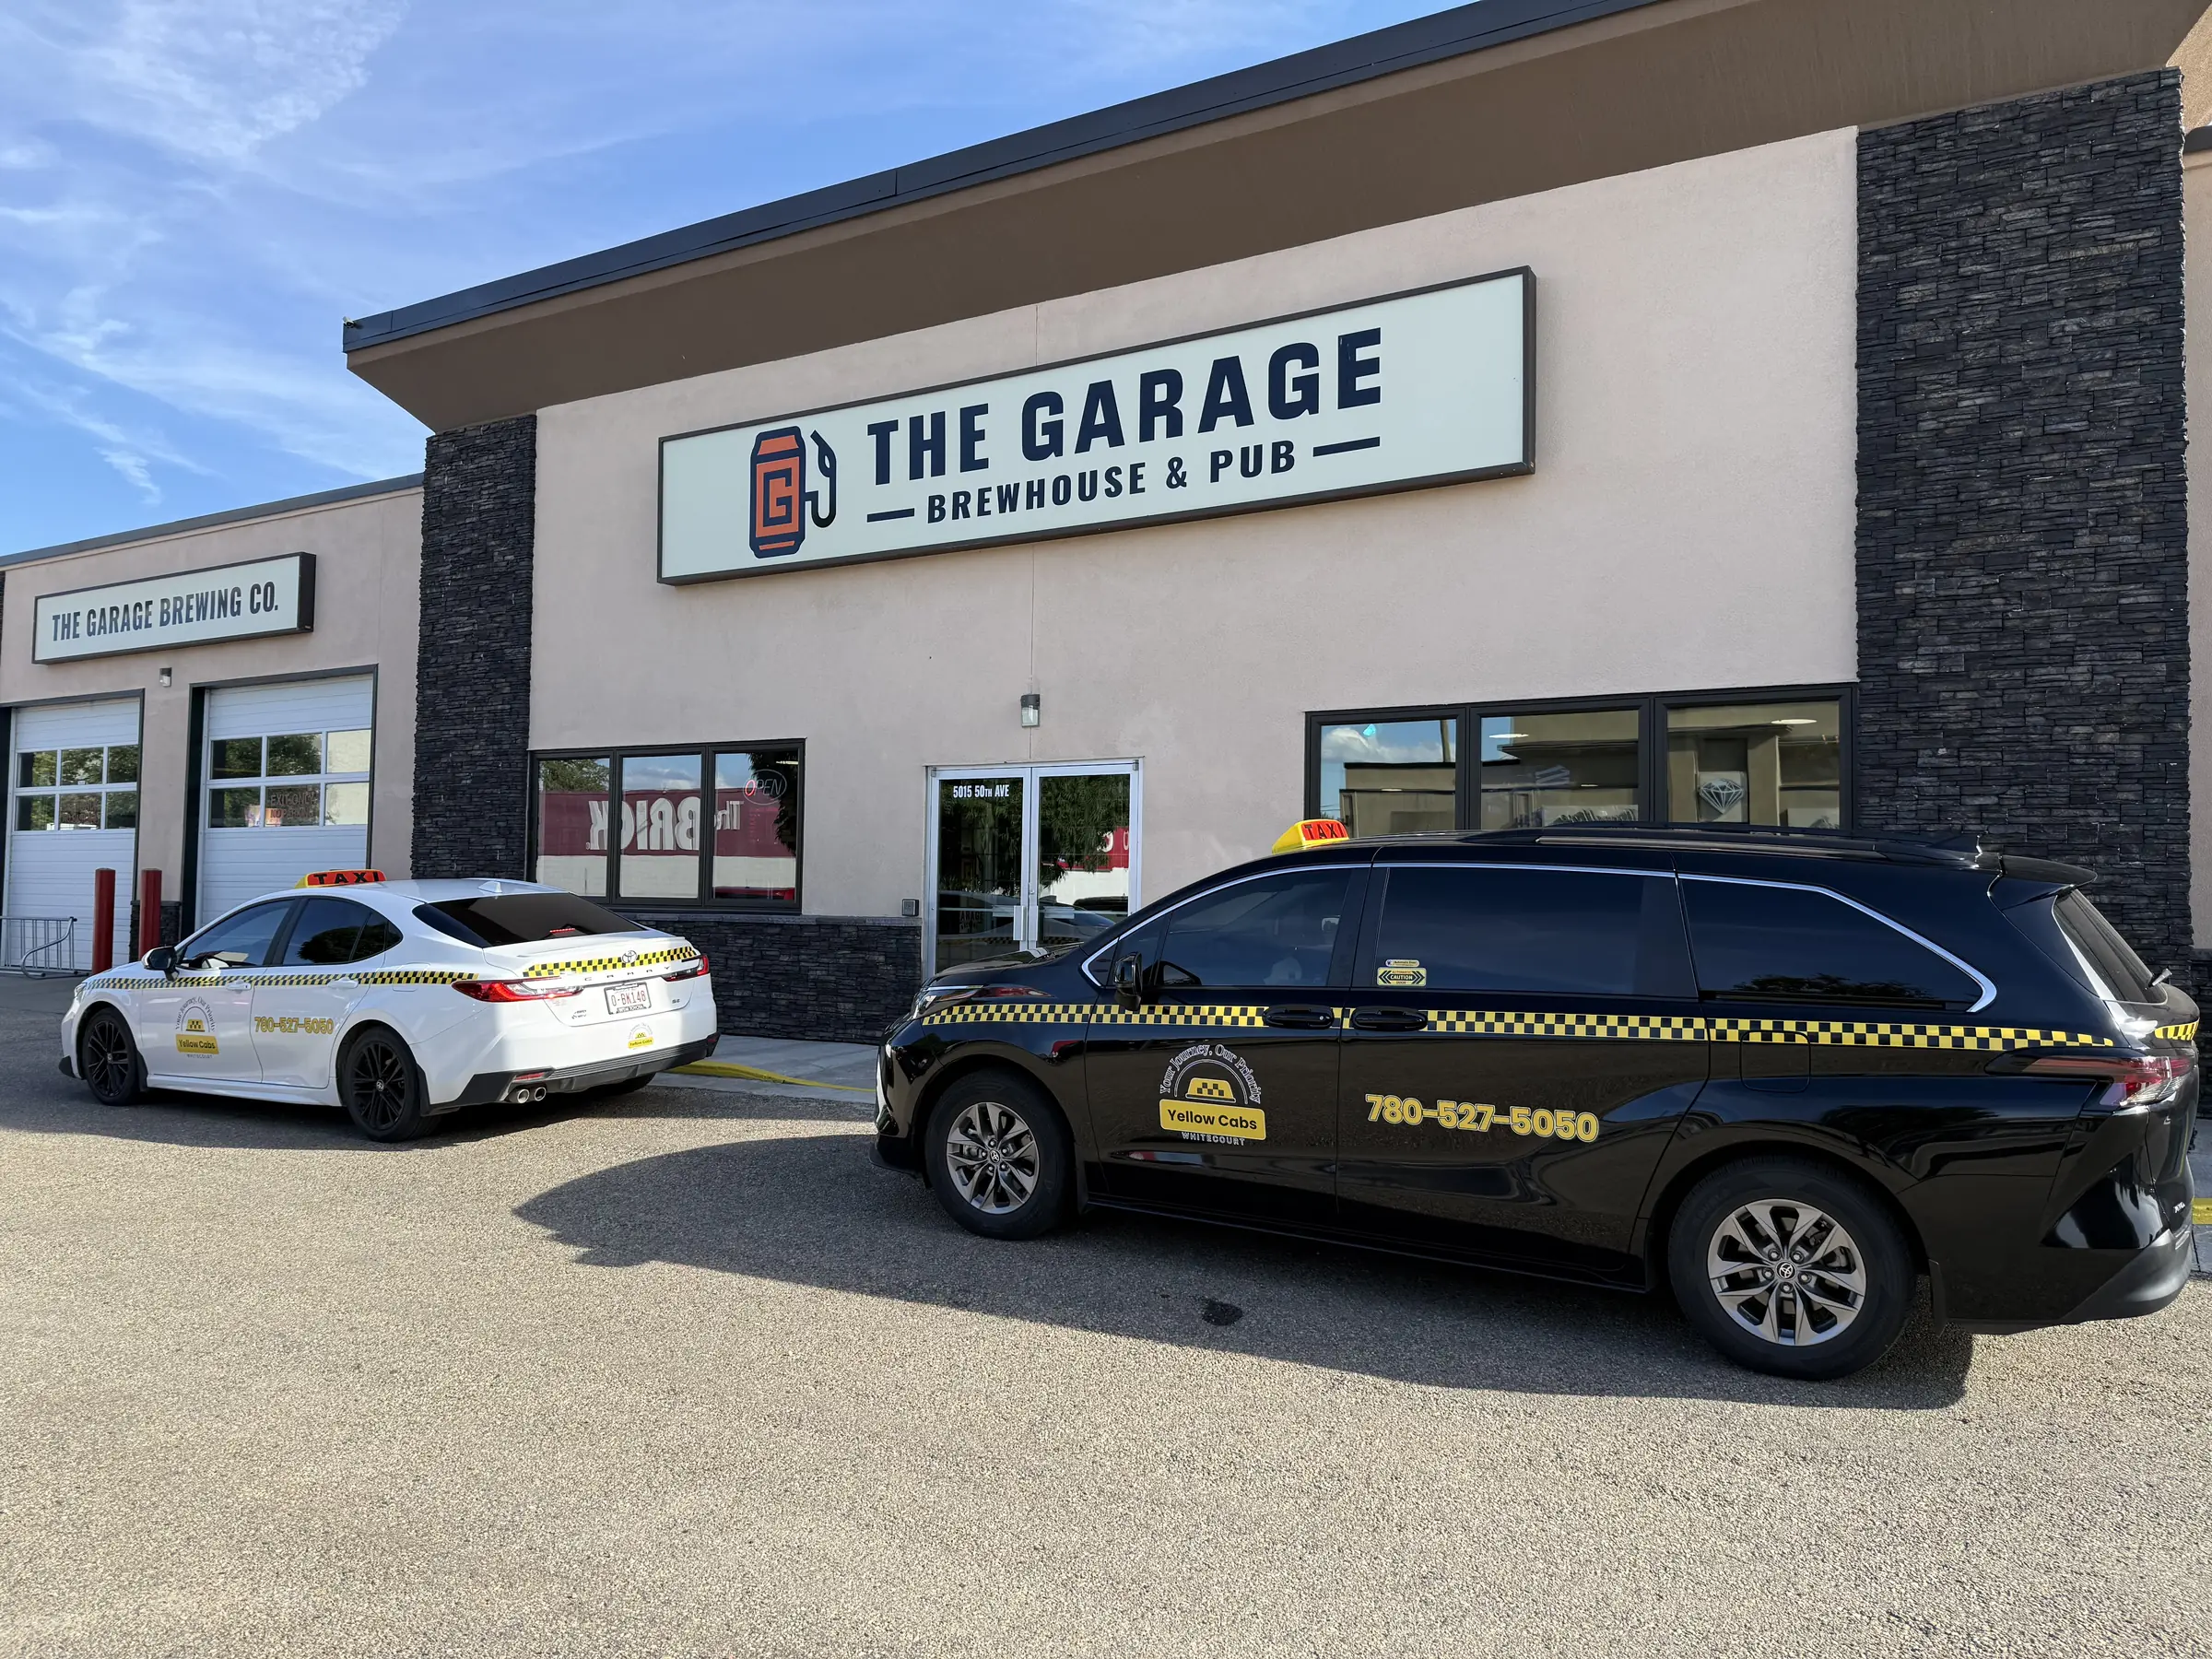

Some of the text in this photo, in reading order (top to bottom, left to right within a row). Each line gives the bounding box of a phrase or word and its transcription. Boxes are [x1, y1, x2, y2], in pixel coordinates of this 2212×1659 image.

[867, 327, 1381, 486] THE GARAGE
[927, 440, 1295, 524] BREWHOUSE & PUB
[52, 581, 278, 641] THE GARAGE BREWING CO.
[745, 779, 782, 796] OPEN
[953, 784, 1010, 798] 5015 50TH AVE
[1304, 823, 1345, 840] TAXI
[314, 871, 380, 885] TAXI
[254, 1017, 335, 1034] 780-527-5050
[179, 1040, 216, 1049] Yellow Cabs
[1159, 1043, 1261, 1104] Your Journey, Our Priority
[1168, 1109, 1257, 1130] Yellow Cabs
[1365, 1093, 1599, 1143] 780-527-5050
[1182, 1132, 1245, 1146] WHITECOURT
